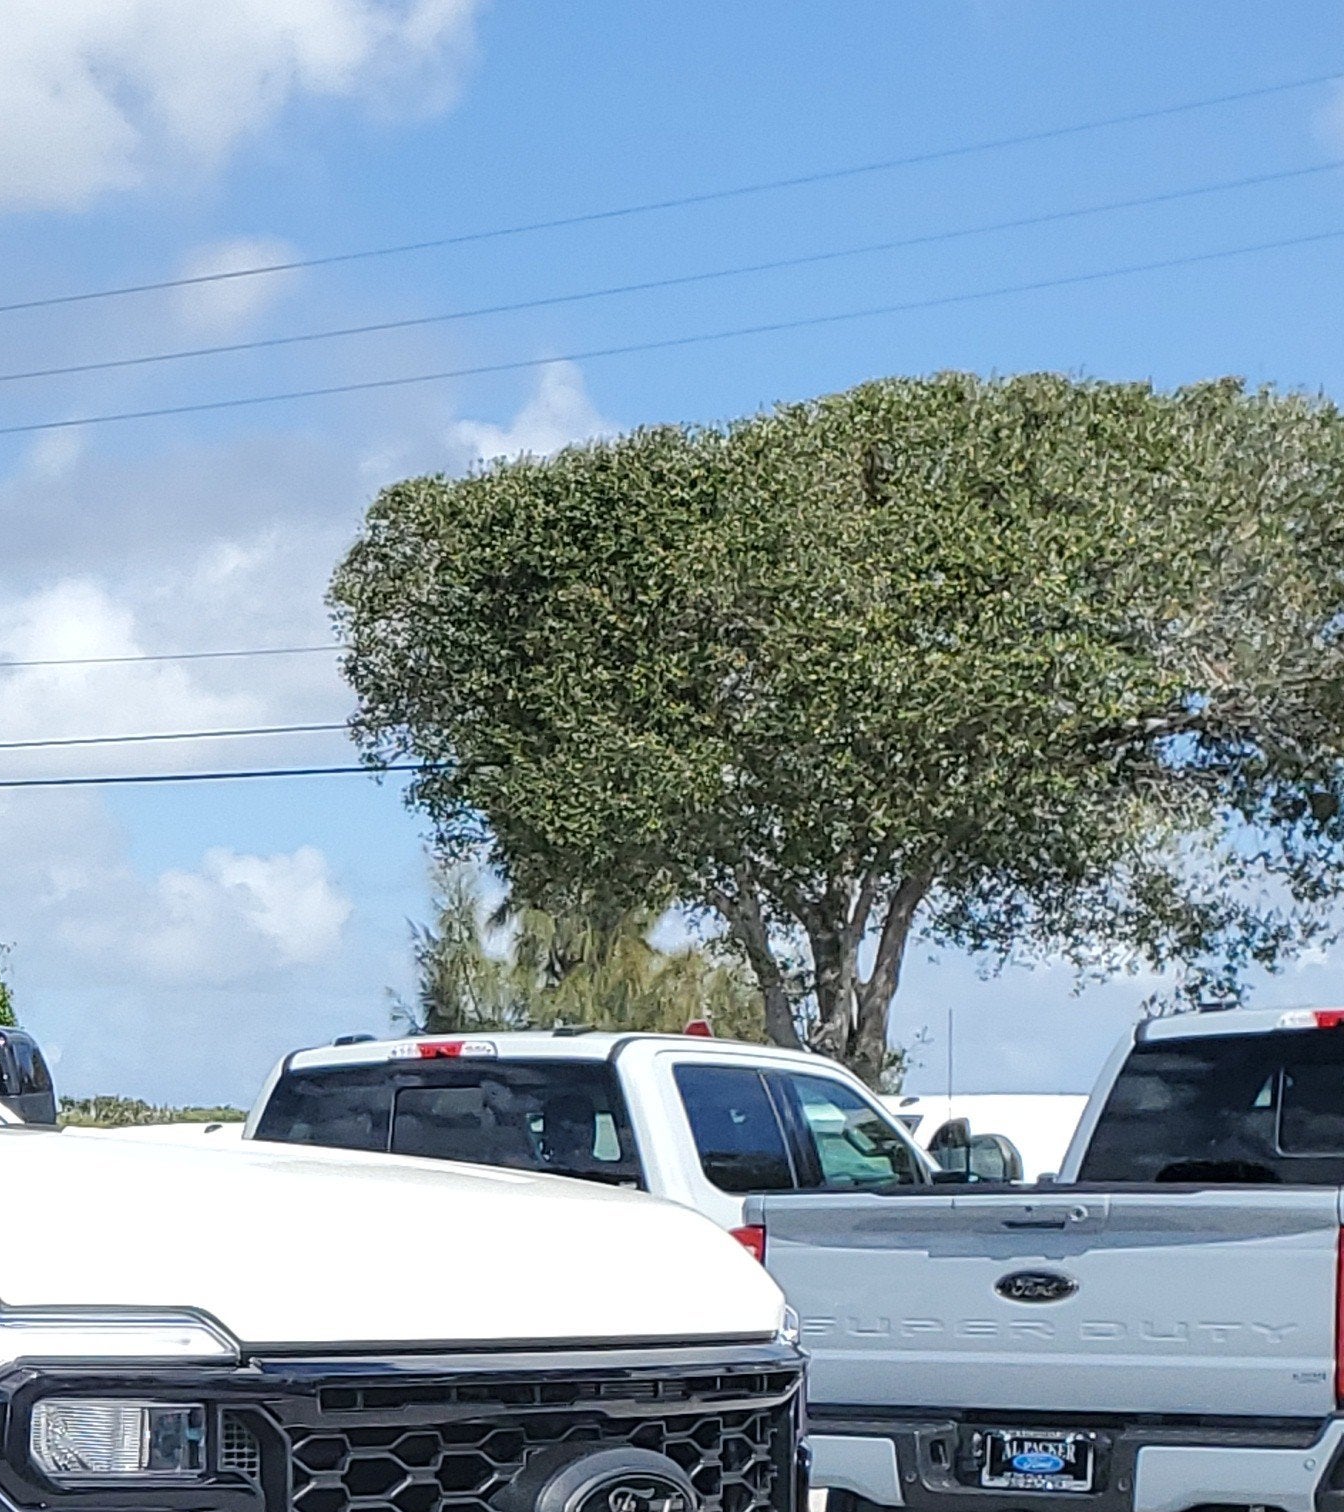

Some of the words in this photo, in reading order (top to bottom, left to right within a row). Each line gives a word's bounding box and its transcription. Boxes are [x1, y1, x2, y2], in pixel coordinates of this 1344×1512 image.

[801, 1315, 1056, 1341] SUPER
[1079, 1319, 1300, 1344] DUTY
[1023, 1441, 1077, 1464] PACKER
